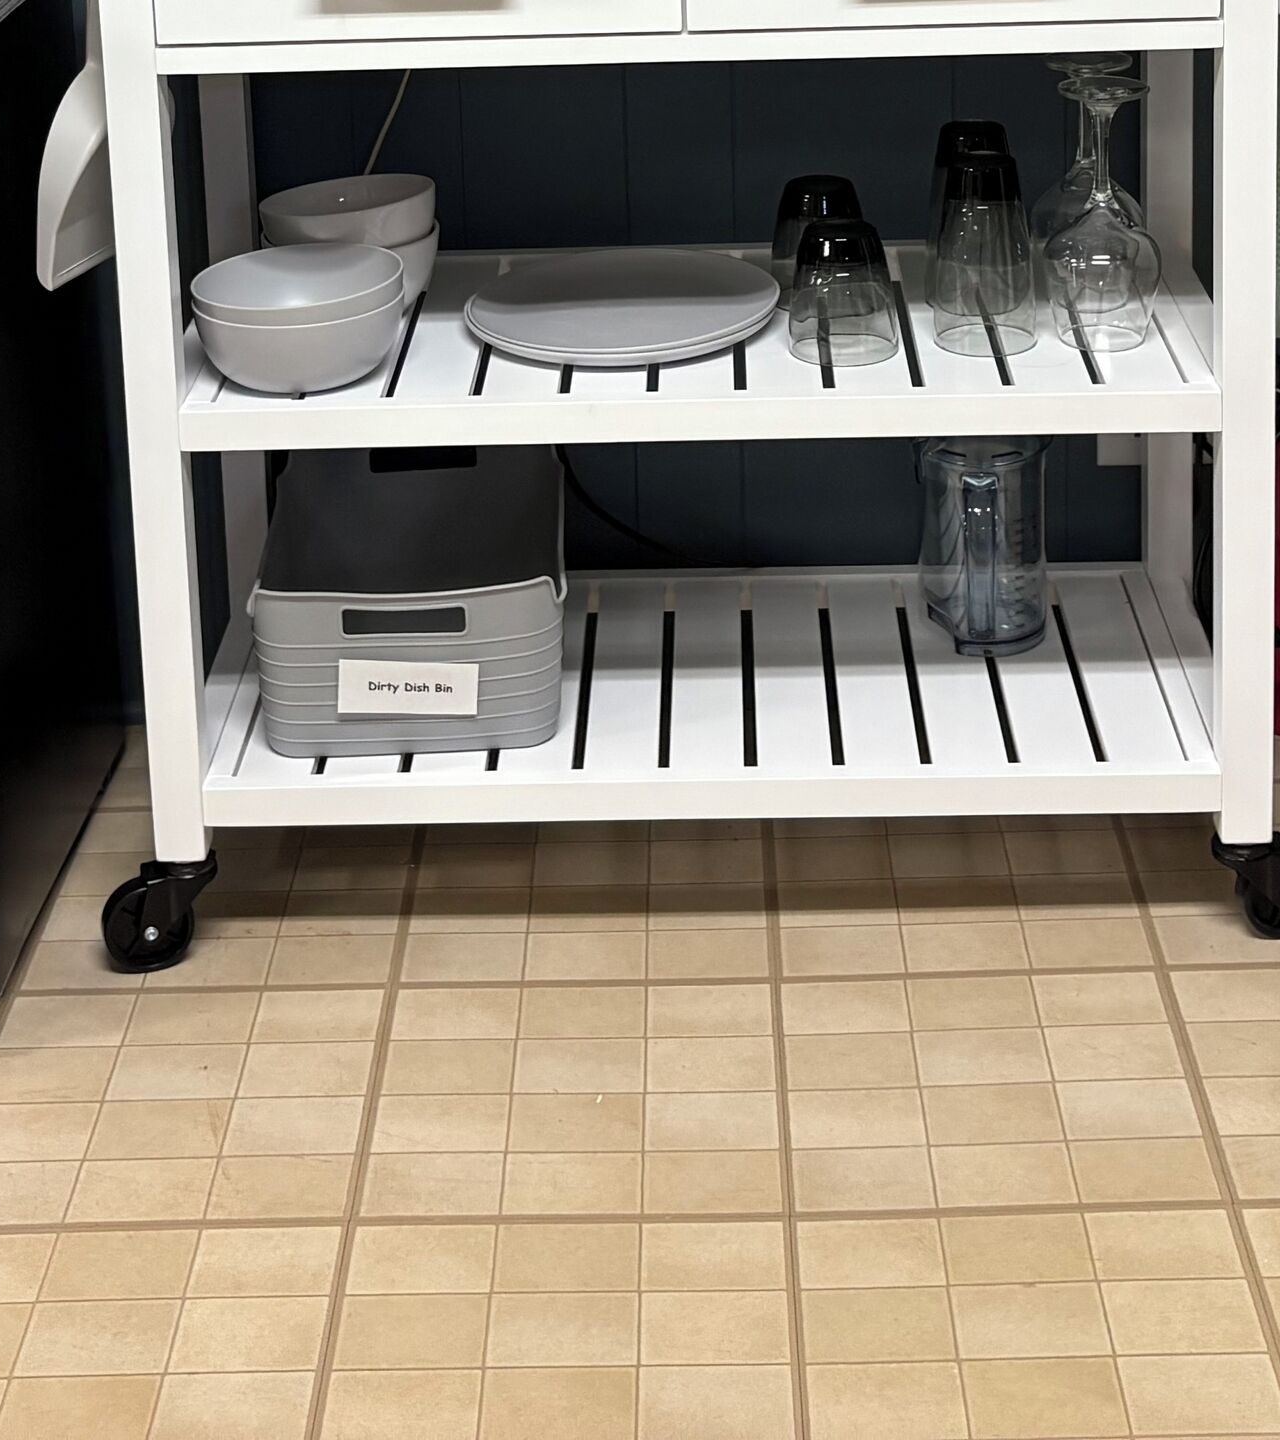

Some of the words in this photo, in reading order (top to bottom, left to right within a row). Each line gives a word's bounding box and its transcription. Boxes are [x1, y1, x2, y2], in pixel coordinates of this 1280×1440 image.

[368, 681, 400, 694] Dirty
[404, 682, 430, 693] Dish
[435, 683, 453, 693] Bin
